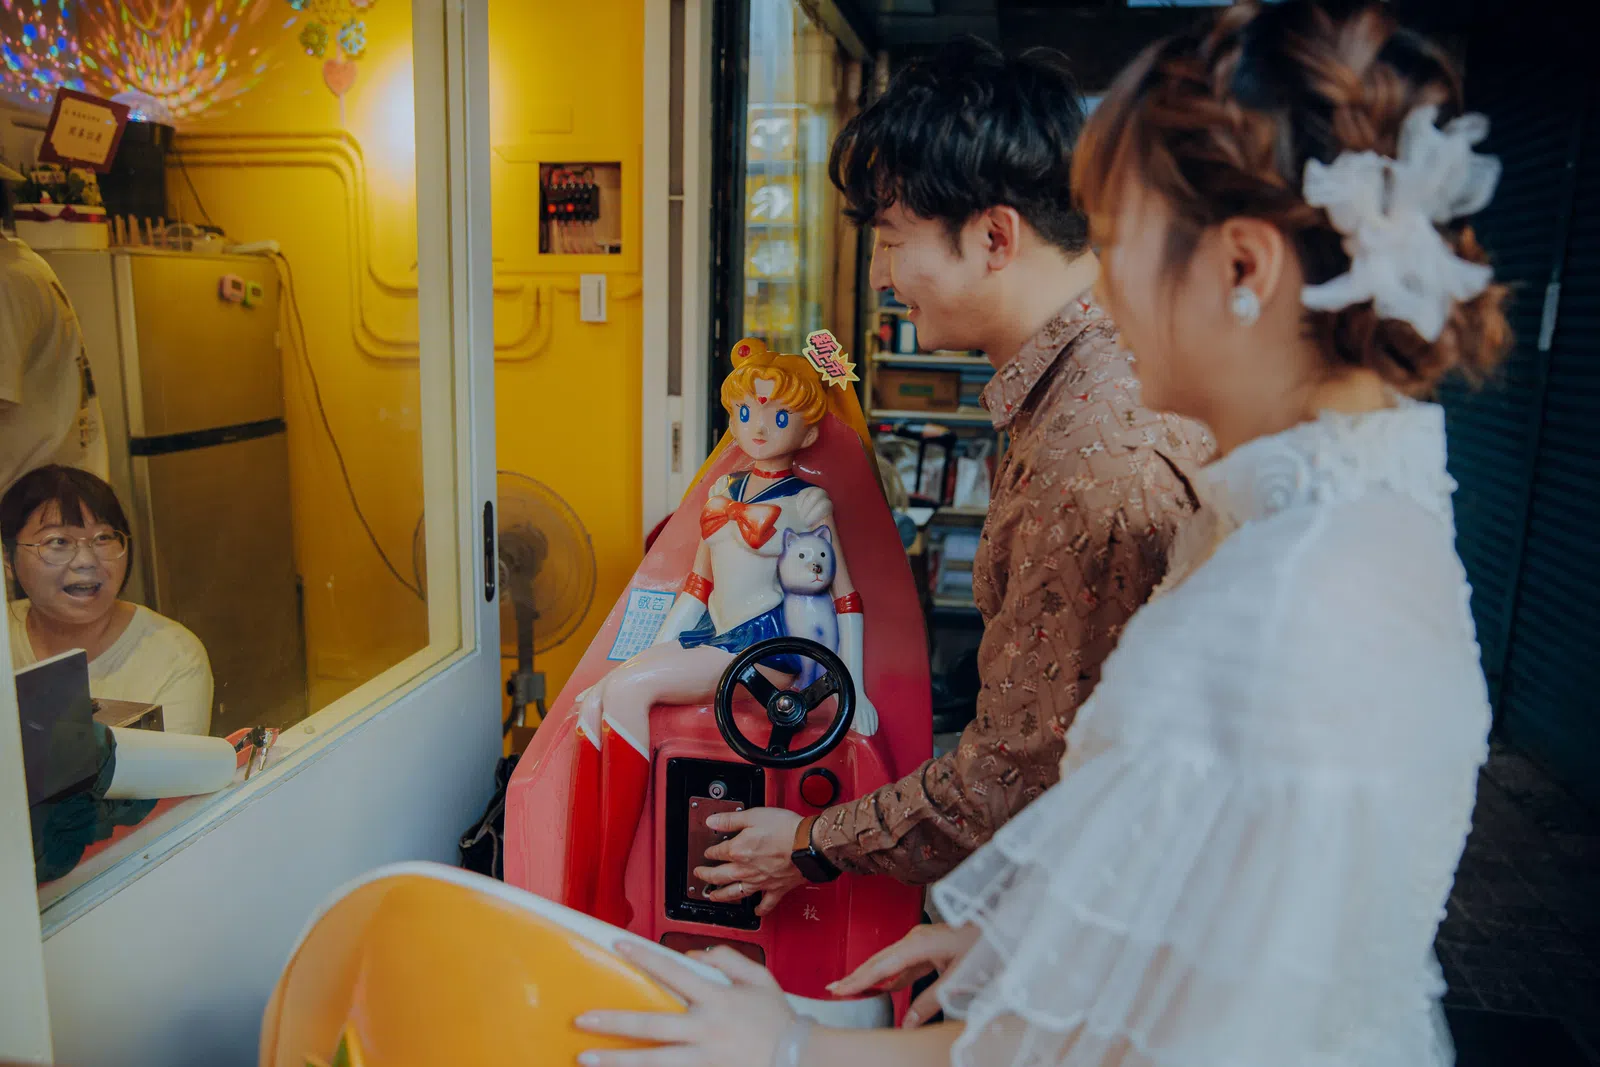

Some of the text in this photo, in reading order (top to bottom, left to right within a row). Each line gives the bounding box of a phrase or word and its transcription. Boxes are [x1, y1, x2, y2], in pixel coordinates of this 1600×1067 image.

[807, 332, 847, 378] 新上市
[638, 595, 666, 611] 敬告
